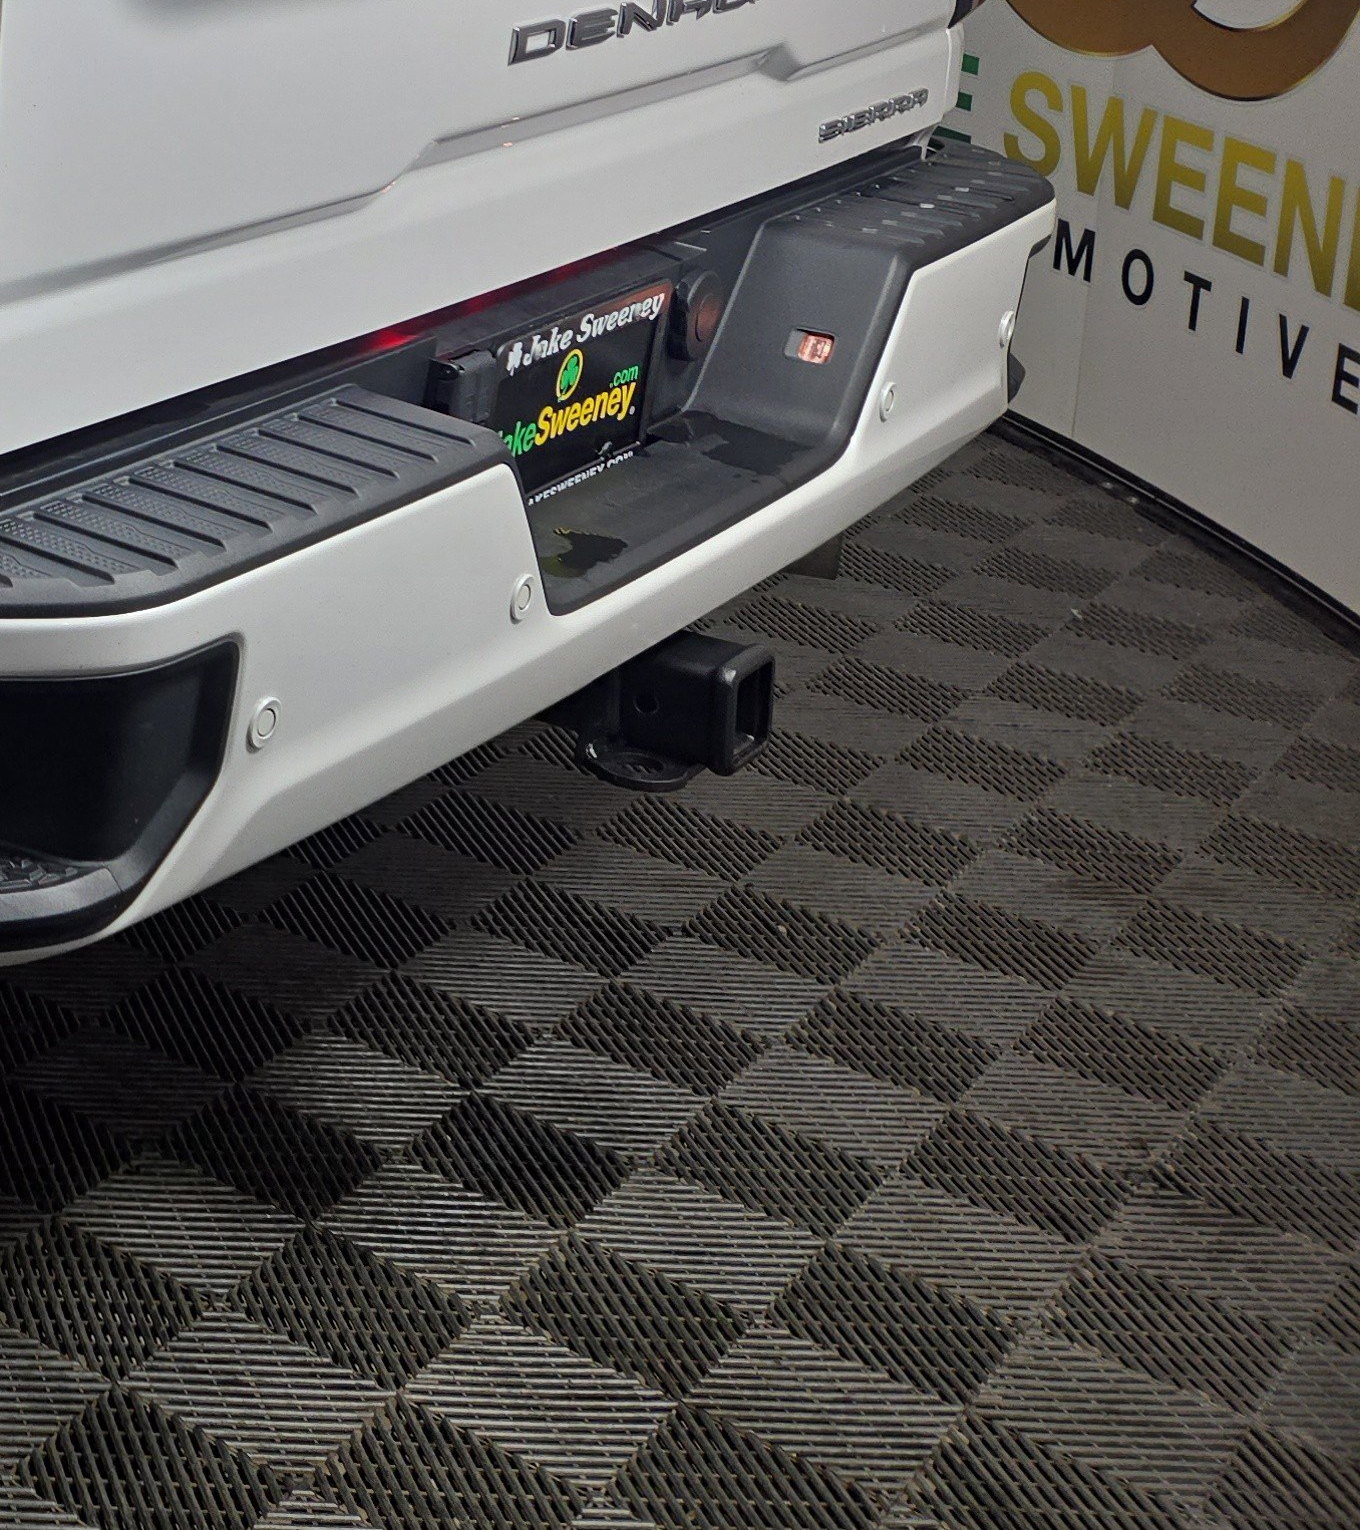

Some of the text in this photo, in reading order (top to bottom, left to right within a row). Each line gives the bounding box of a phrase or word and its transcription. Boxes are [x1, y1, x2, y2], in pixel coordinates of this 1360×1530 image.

[818, 87, 930, 144] SIERRA
[1003, 71, 1360, 315] SWEEN
[523, 292, 665, 366] Jake Sweeney
[1053, 217, 1360, 415] MOTIVE
